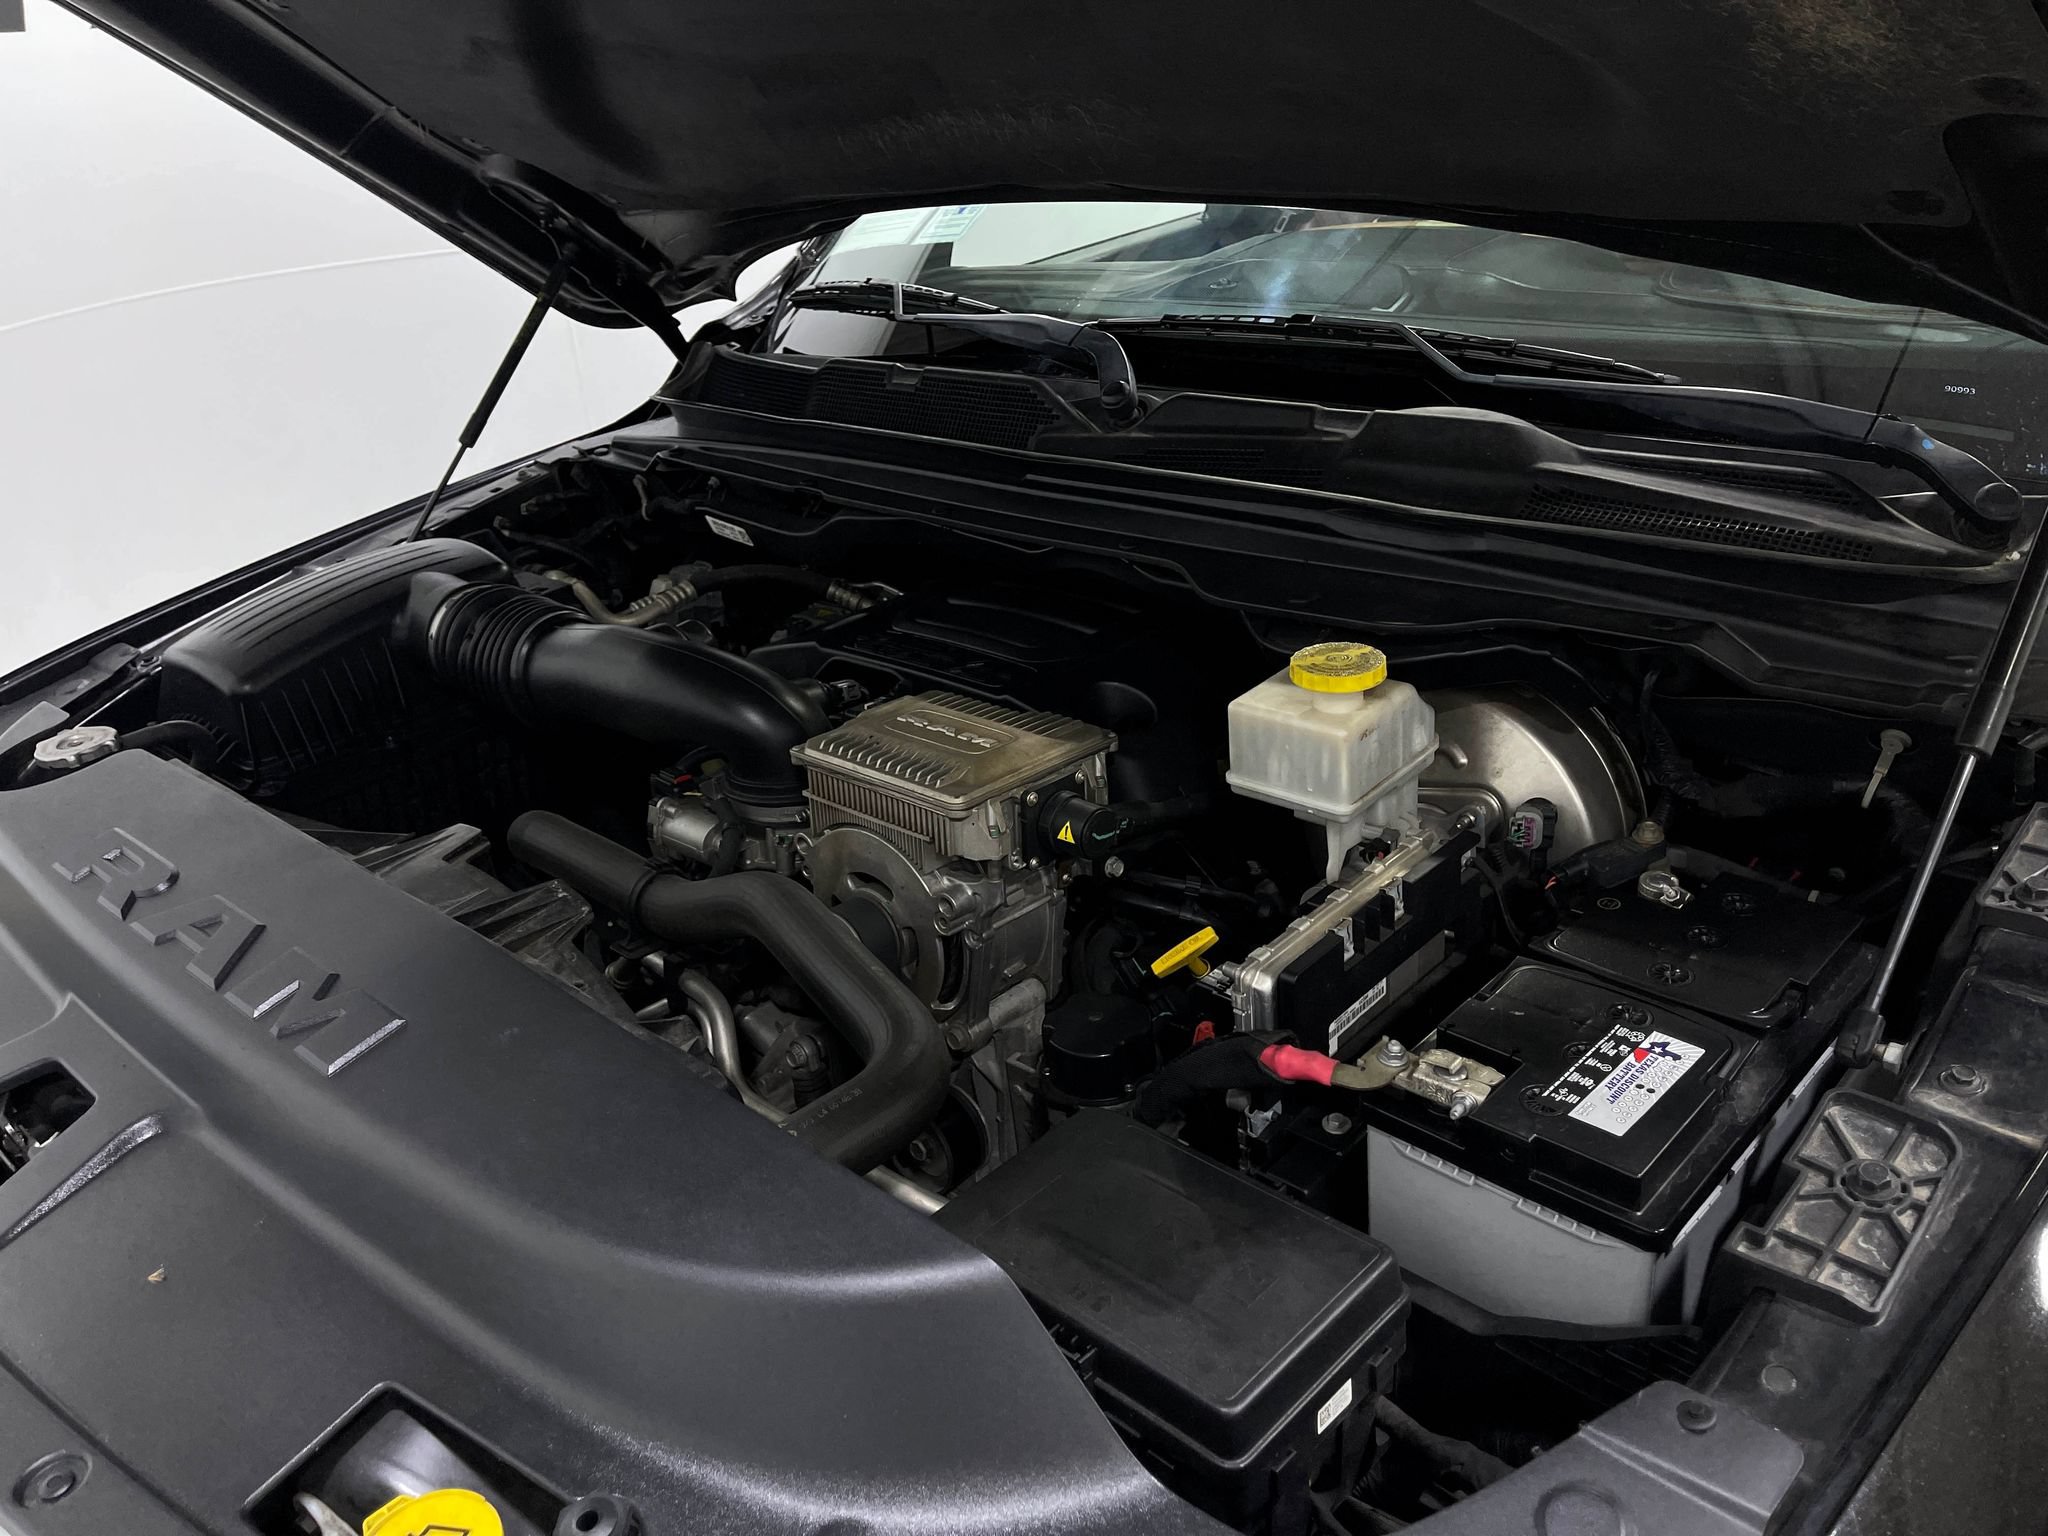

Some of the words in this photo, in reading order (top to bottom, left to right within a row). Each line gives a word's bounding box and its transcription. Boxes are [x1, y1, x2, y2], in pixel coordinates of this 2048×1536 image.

[1944, 385, 1976, 395] 90993
[896, 714, 999, 748] RAM
[51, 826, 408, 1078] RAM
[1604, 1061, 1637, 1092] BATTERY
[1638, 1055, 1660, 1076] TEXAS
[1606, 1074, 1640, 1105] DISCOUNT
